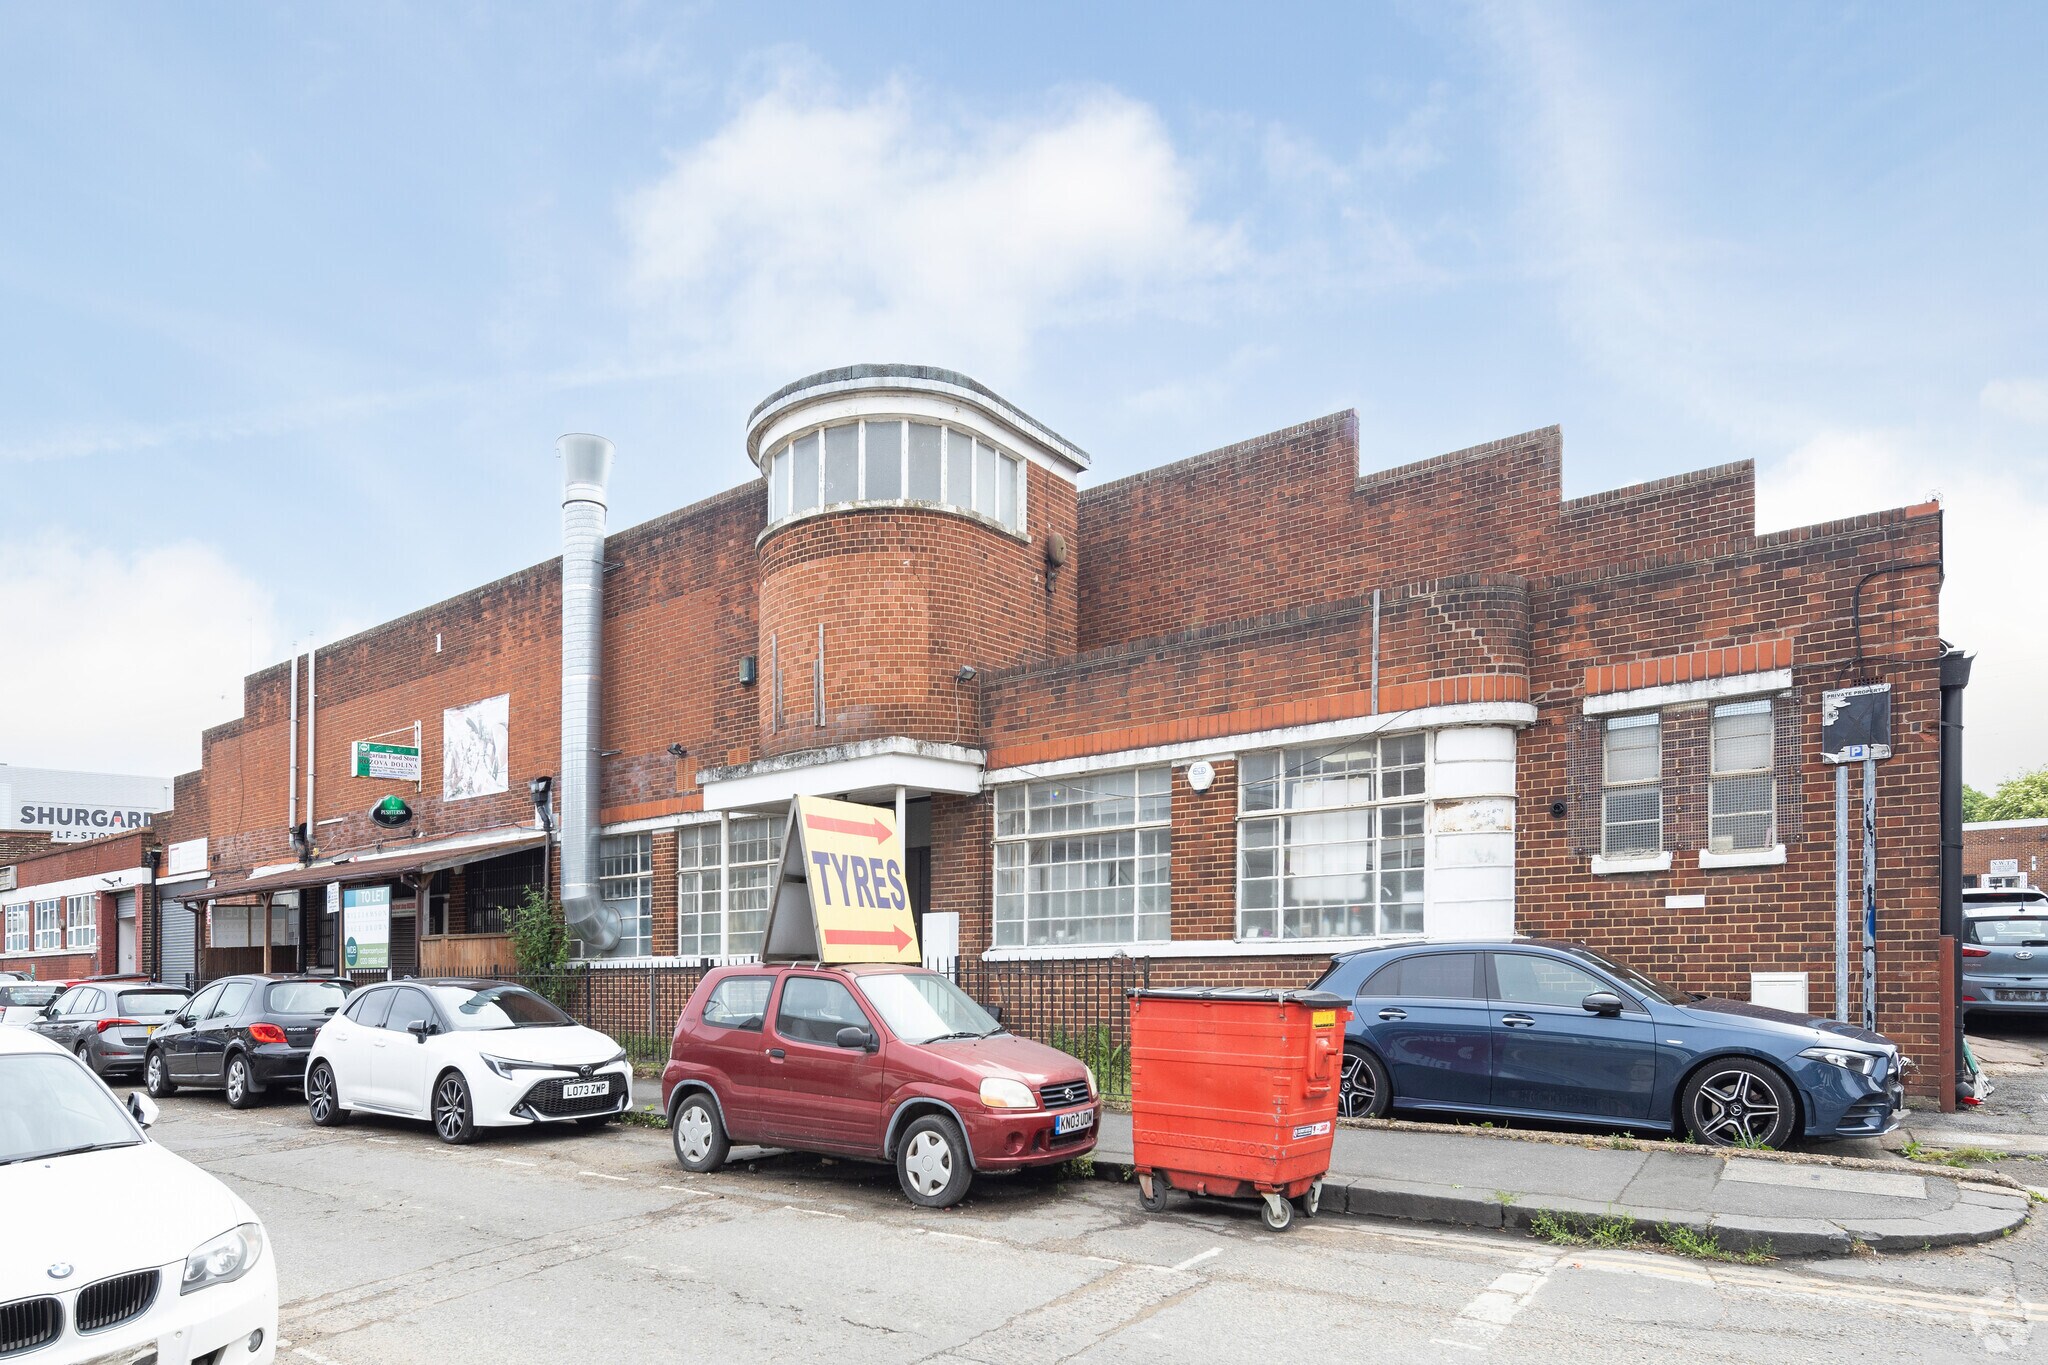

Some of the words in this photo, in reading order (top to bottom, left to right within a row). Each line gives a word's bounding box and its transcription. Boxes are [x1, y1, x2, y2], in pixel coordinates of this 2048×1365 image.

[1826, 691, 1852, 699] PRIVATE
[1853, 687, 1886, 695] PROPERTY
[359, 758, 388, 767] ROZOVA
[390, 761, 418, 769] DOLINA
[403, 755, 418, 763] Store
[811, 850, 906, 911] TYRES
[361, 890, 371, 903] TO
[371, 889, 385, 902] LET
[567, 1085, 589, 1097] LO73
